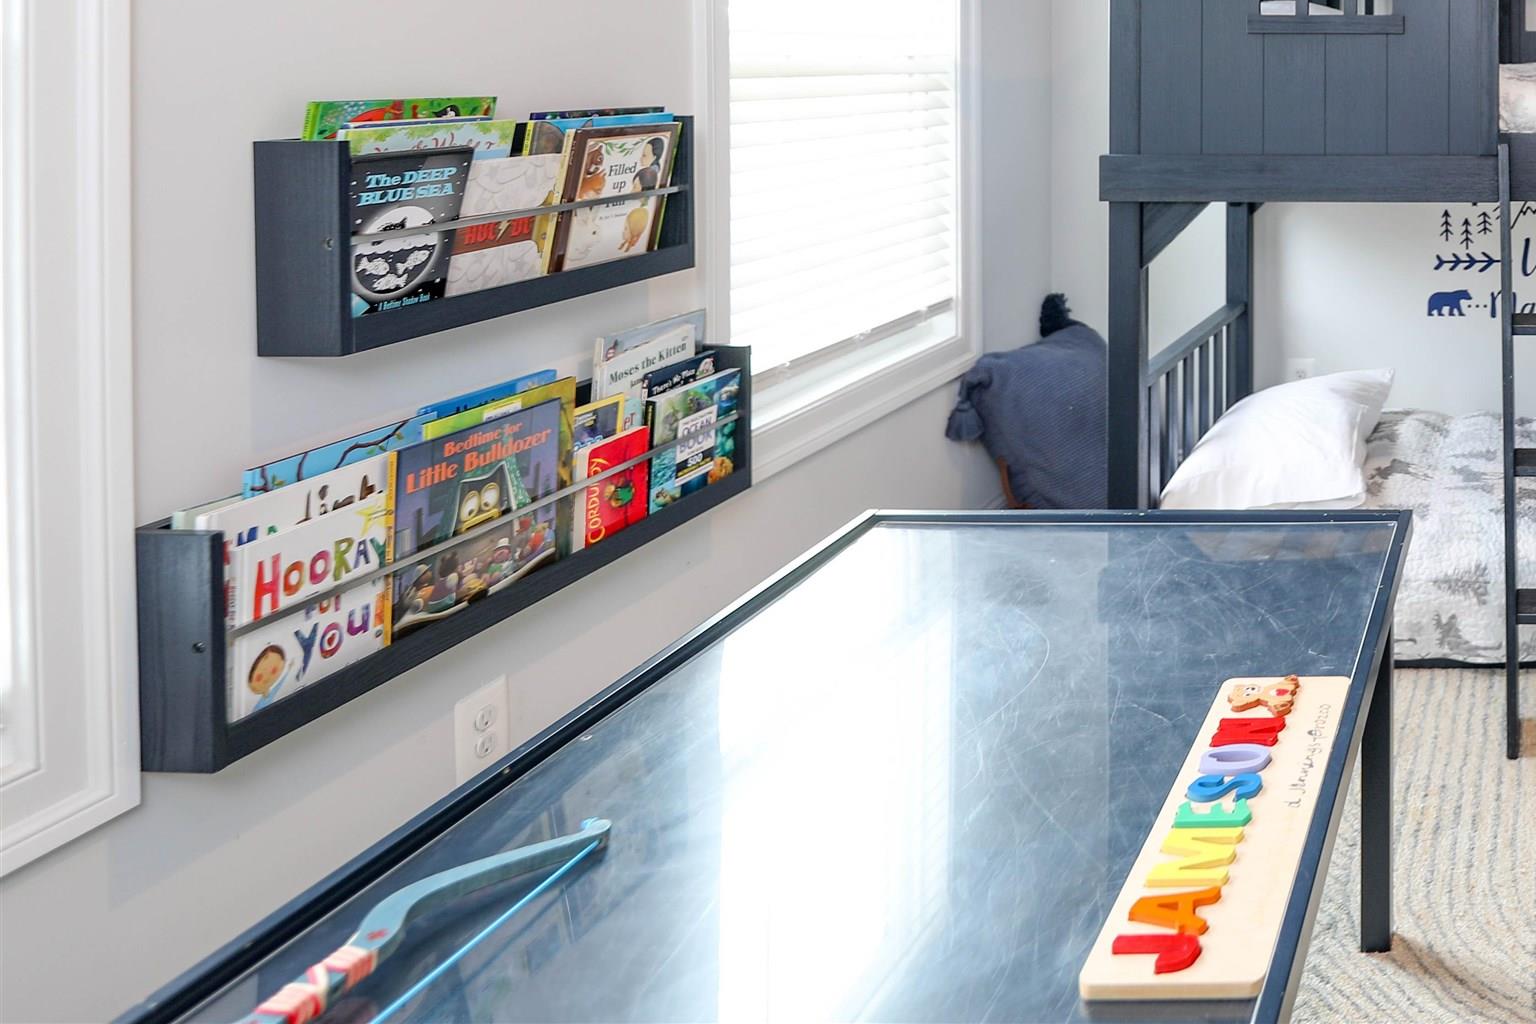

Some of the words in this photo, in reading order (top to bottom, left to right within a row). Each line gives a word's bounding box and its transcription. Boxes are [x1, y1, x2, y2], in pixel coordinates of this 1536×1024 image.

[365, 174, 402, 189] The
[400, 167, 457, 185] DEEP
[608, 162, 638, 177] Filled
[612, 180, 626, 193] up
[356, 187, 417, 206] BLUE
[414, 182, 455, 199] SEA
[608, 363, 641, 385] Moses
[641, 355, 657, 370] the
[657, 342, 688, 363] Kitten
[443, 429, 501, 458] Bedtime
[503, 422, 523, 436] for
[405, 462, 459, 495] Little
[463, 429, 552, 473] Bulldozer
[588, 458, 611, 544] CORDUOY
[253, 536, 387, 622] HOORAY
[1111, 715, 1287, 975] JAMESON
